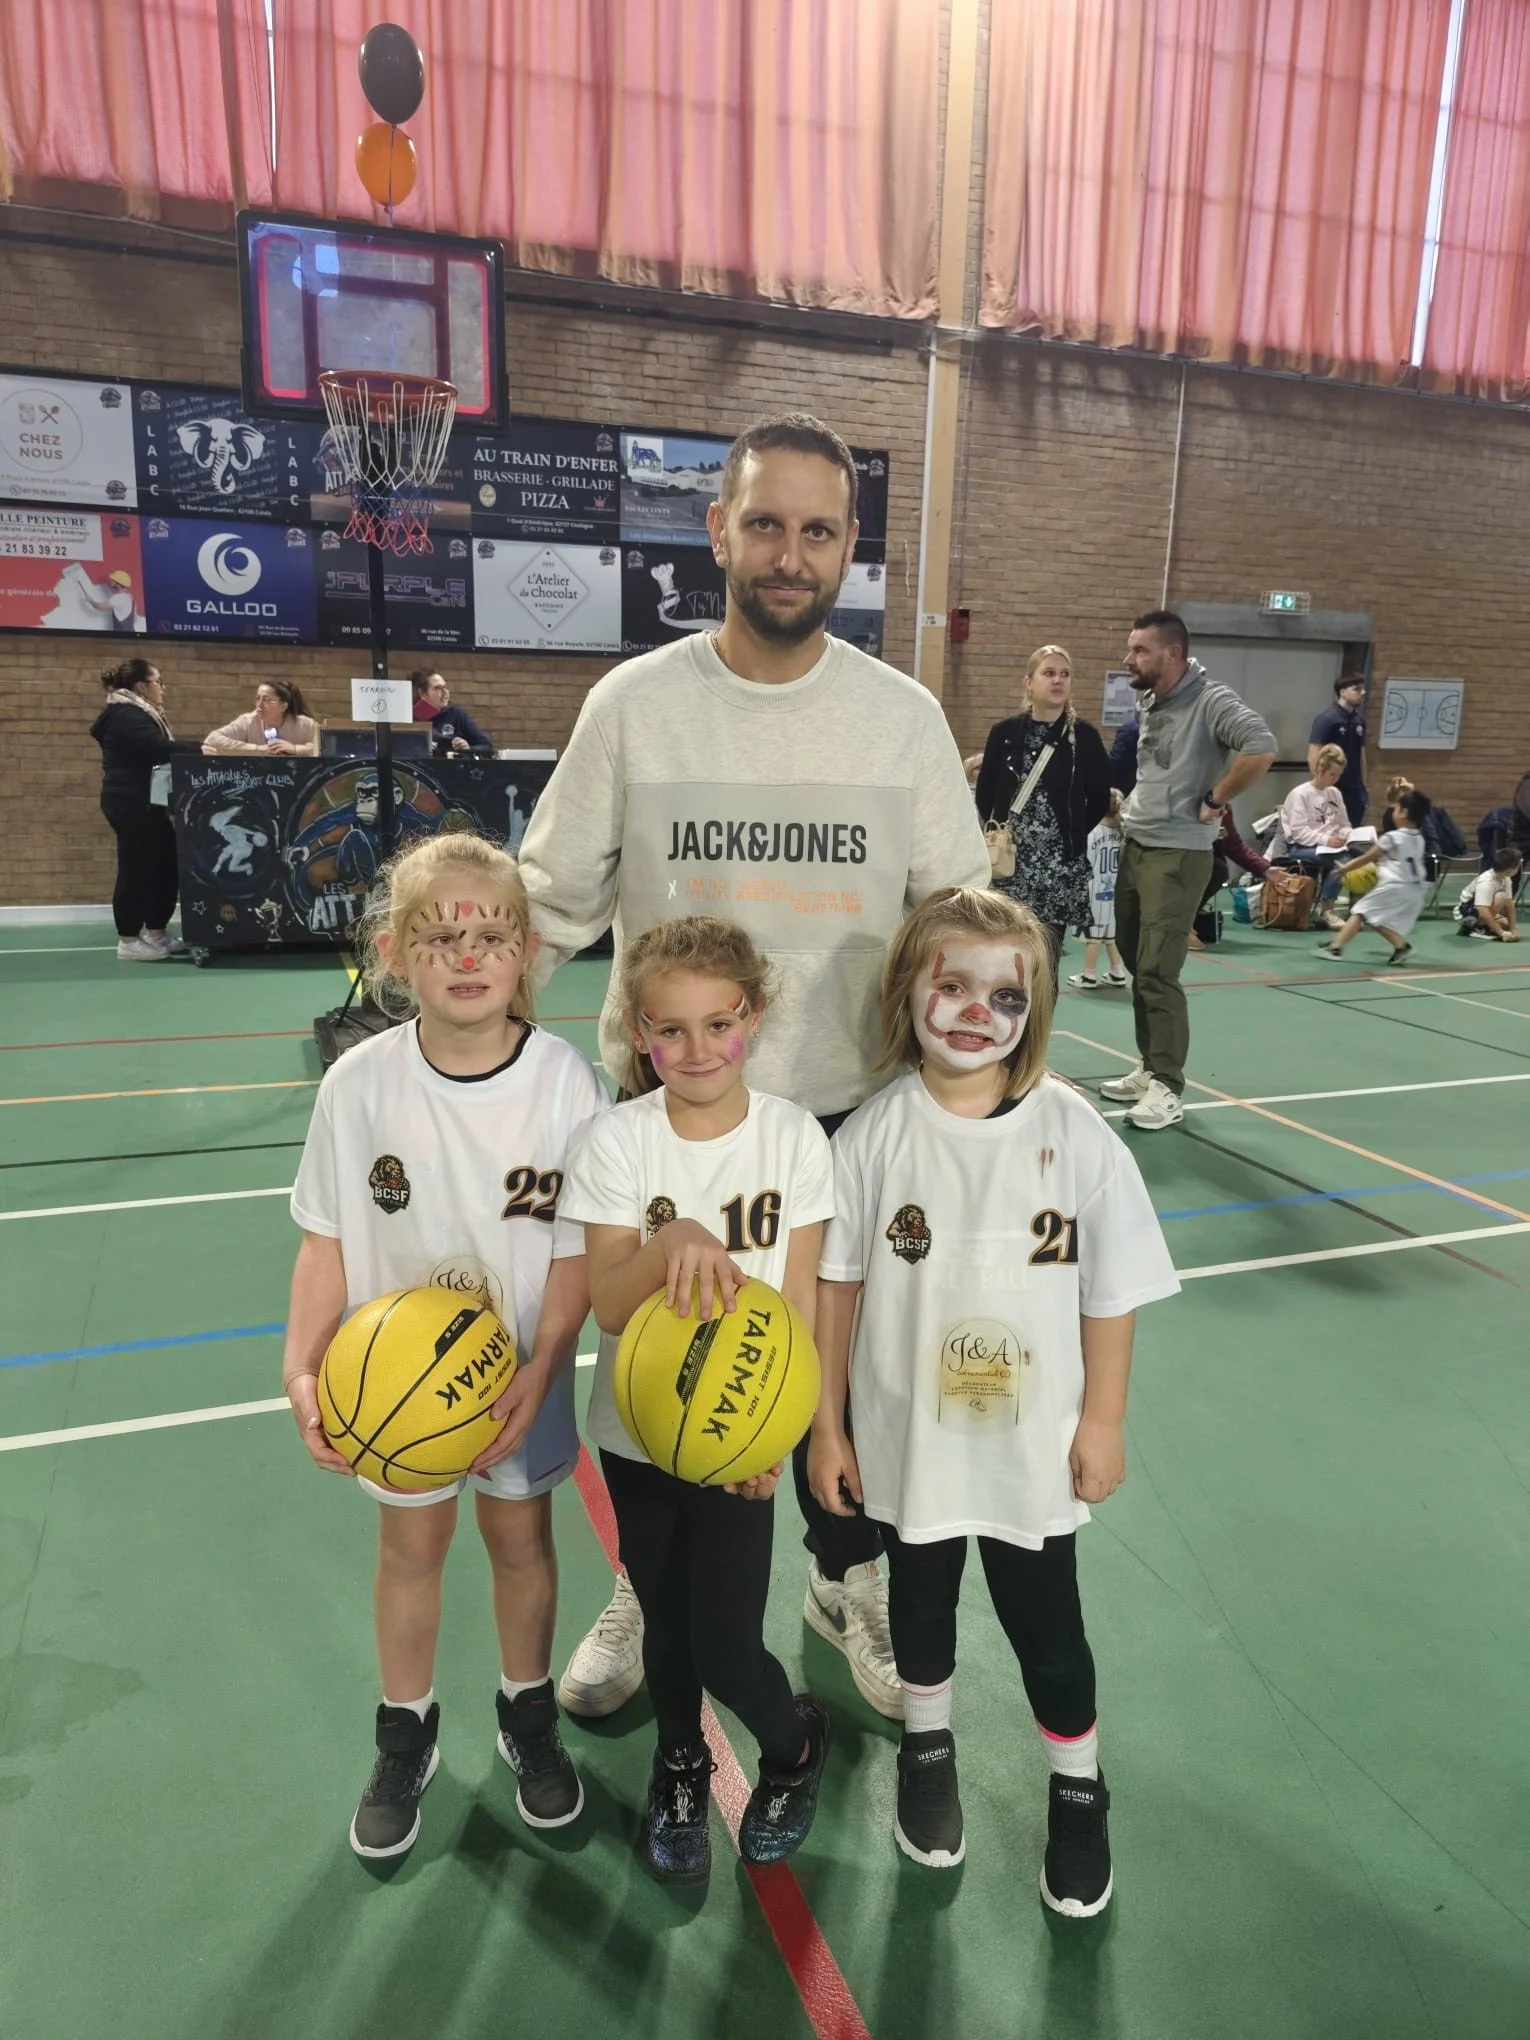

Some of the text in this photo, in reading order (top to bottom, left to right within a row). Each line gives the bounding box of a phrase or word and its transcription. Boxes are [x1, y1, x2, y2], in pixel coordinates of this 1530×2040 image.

[19, 433, 61, 446] CHEZ
[19, 447, 63, 460] NOUS
[473, 448, 619, 473] AU TRAIN D'ENFER
[473, 469, 543, 486] BRASSERIE
[552, 475, 616, 491] GRILLADE
[521, 491, 570, 510] PIZZA
[26, 515, 87, 527] PEINTURE
[6, 543, 67, 556] 21 83 39 22
[527, 573, 570, 586] L'Atelier
[531, 586, 578, 600] Chocolat
[186, 600, 277, 617] GALLOO
[360, 686, 396, 694] TERRAIN
[667, 820, 867, 865] JACK&JONES
[323, 883, 346, 895] LES
[374, 1187, 409, 1202] BCSF
[501, 1166, 564, 1225] 22
[720, 1189, 782, 1255] 16
[894, 1237, 930, 1251] BCSF
[1027, 1208, 1079, 1266] 21
[451, 1316, 464, 1332] SIZE
[435, 1323, 510, 1410] TARMAK
[701, 1308, 772, 1443] TARMAK
[917, 1746, 949, 1761] SKECHERS
[1059, 1789, 1094, 1801] SKECHERS
